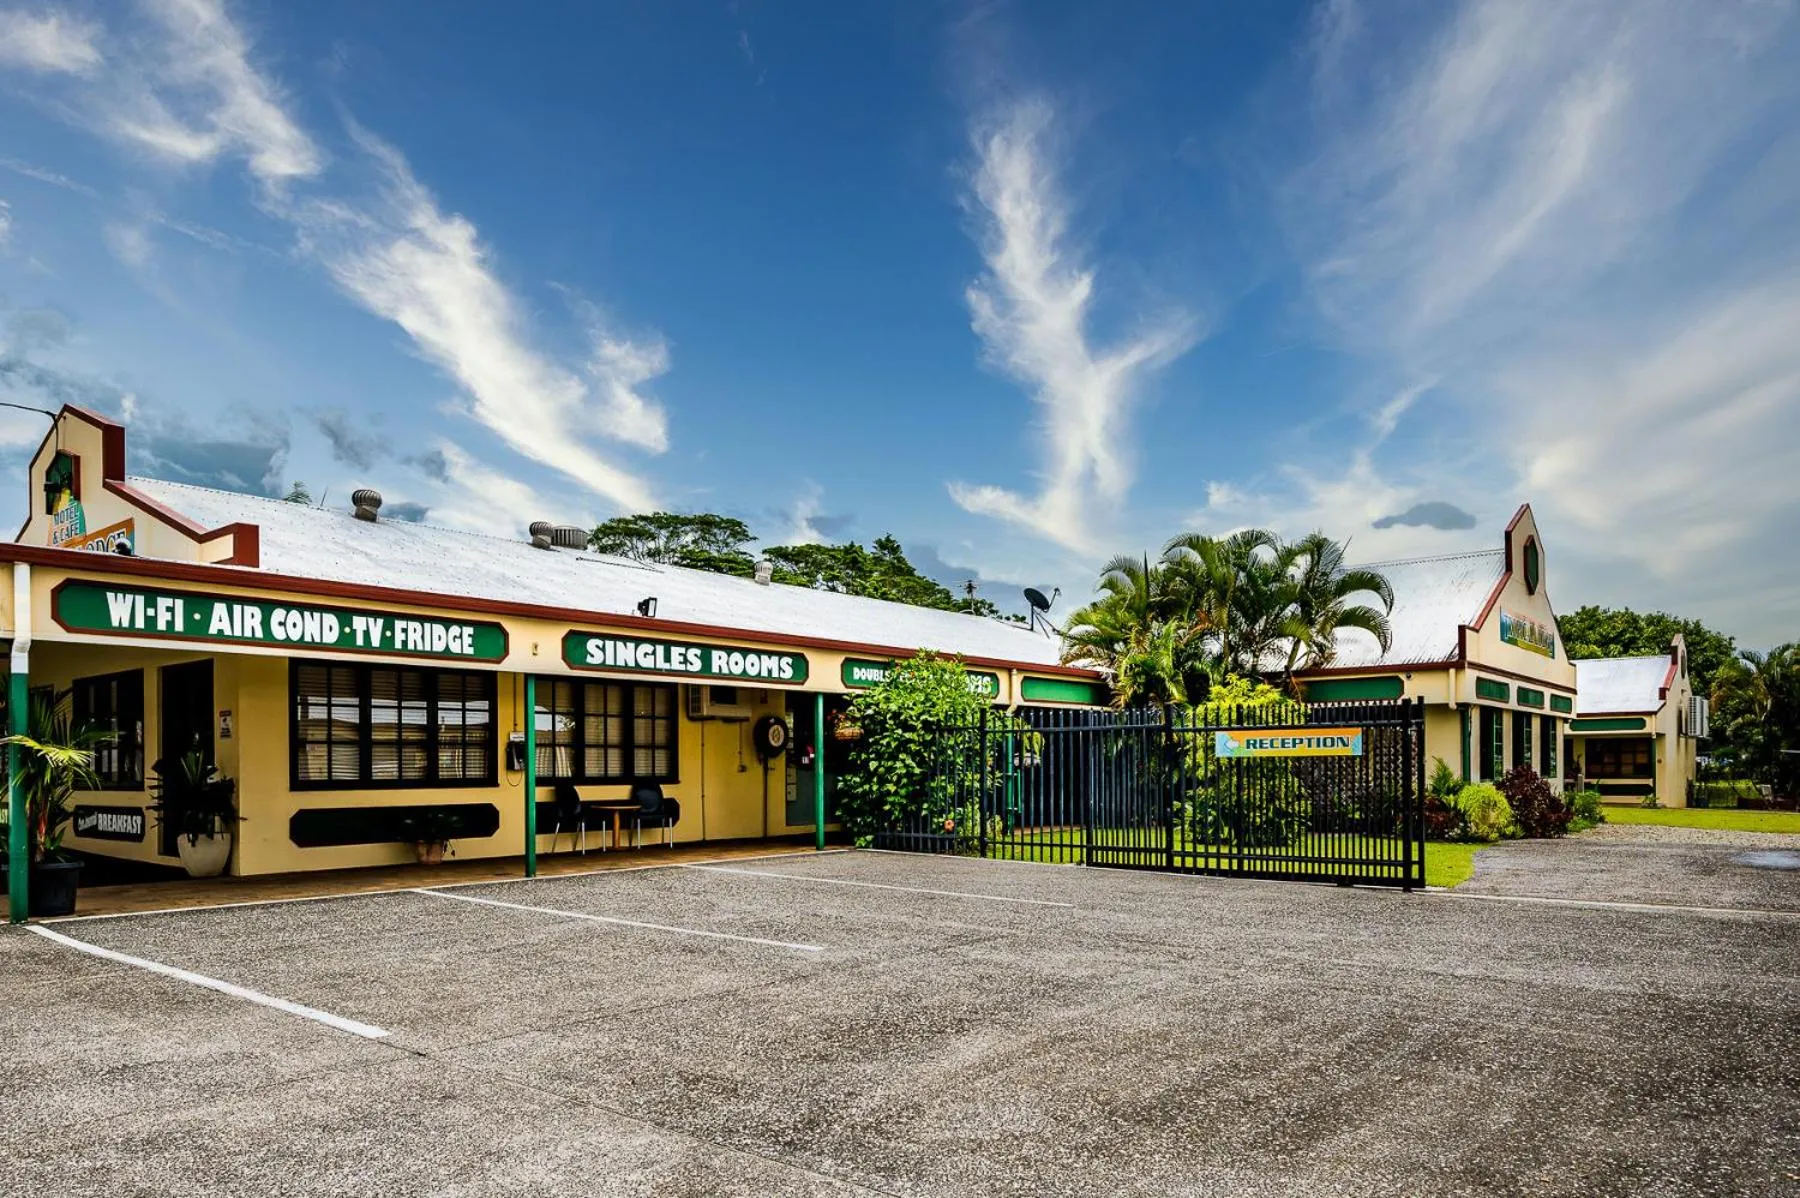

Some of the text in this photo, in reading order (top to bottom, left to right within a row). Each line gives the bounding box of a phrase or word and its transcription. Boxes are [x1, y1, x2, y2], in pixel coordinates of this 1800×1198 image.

[53, 522, 80, 545] & CAFE
[78, 528, 127, 553] ODGE
[106, 592, 475, 655] WI-FI AIR COND TV FRIDGE
[586, 638, 793, 679] SINGLES ROOMS
[1245, 736, 1350, 750] RECEPTION
[97, 813, 142, 835] BREAKFAST
